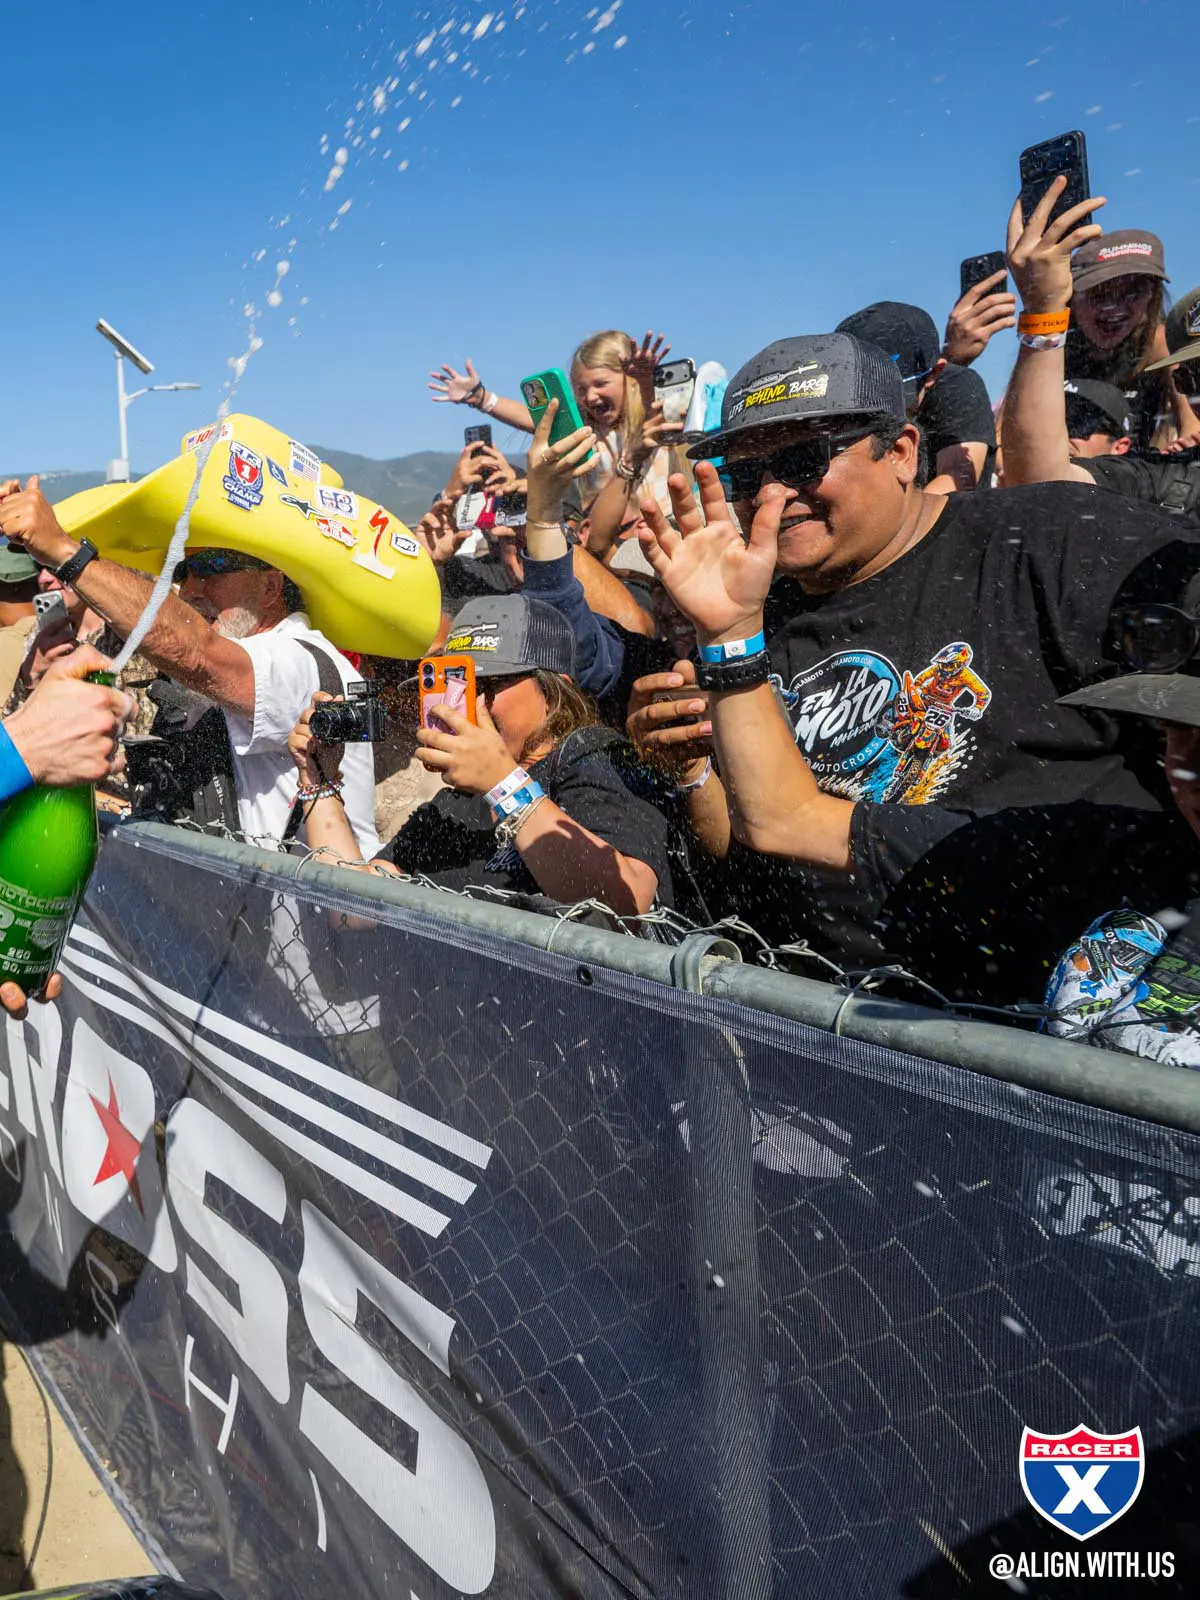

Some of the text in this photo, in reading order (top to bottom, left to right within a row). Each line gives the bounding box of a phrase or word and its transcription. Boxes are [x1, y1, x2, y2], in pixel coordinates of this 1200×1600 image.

[728, 377, 828, 421] LIFE BEHIND BARS
[240, 464, 251, 480] 1
[224, 482, 261, 505] CHAMP
[800, 667, 869, 714] EN LA
[795, 678, 893, 752] MOTO
[926, 711, 951, 727] 26
